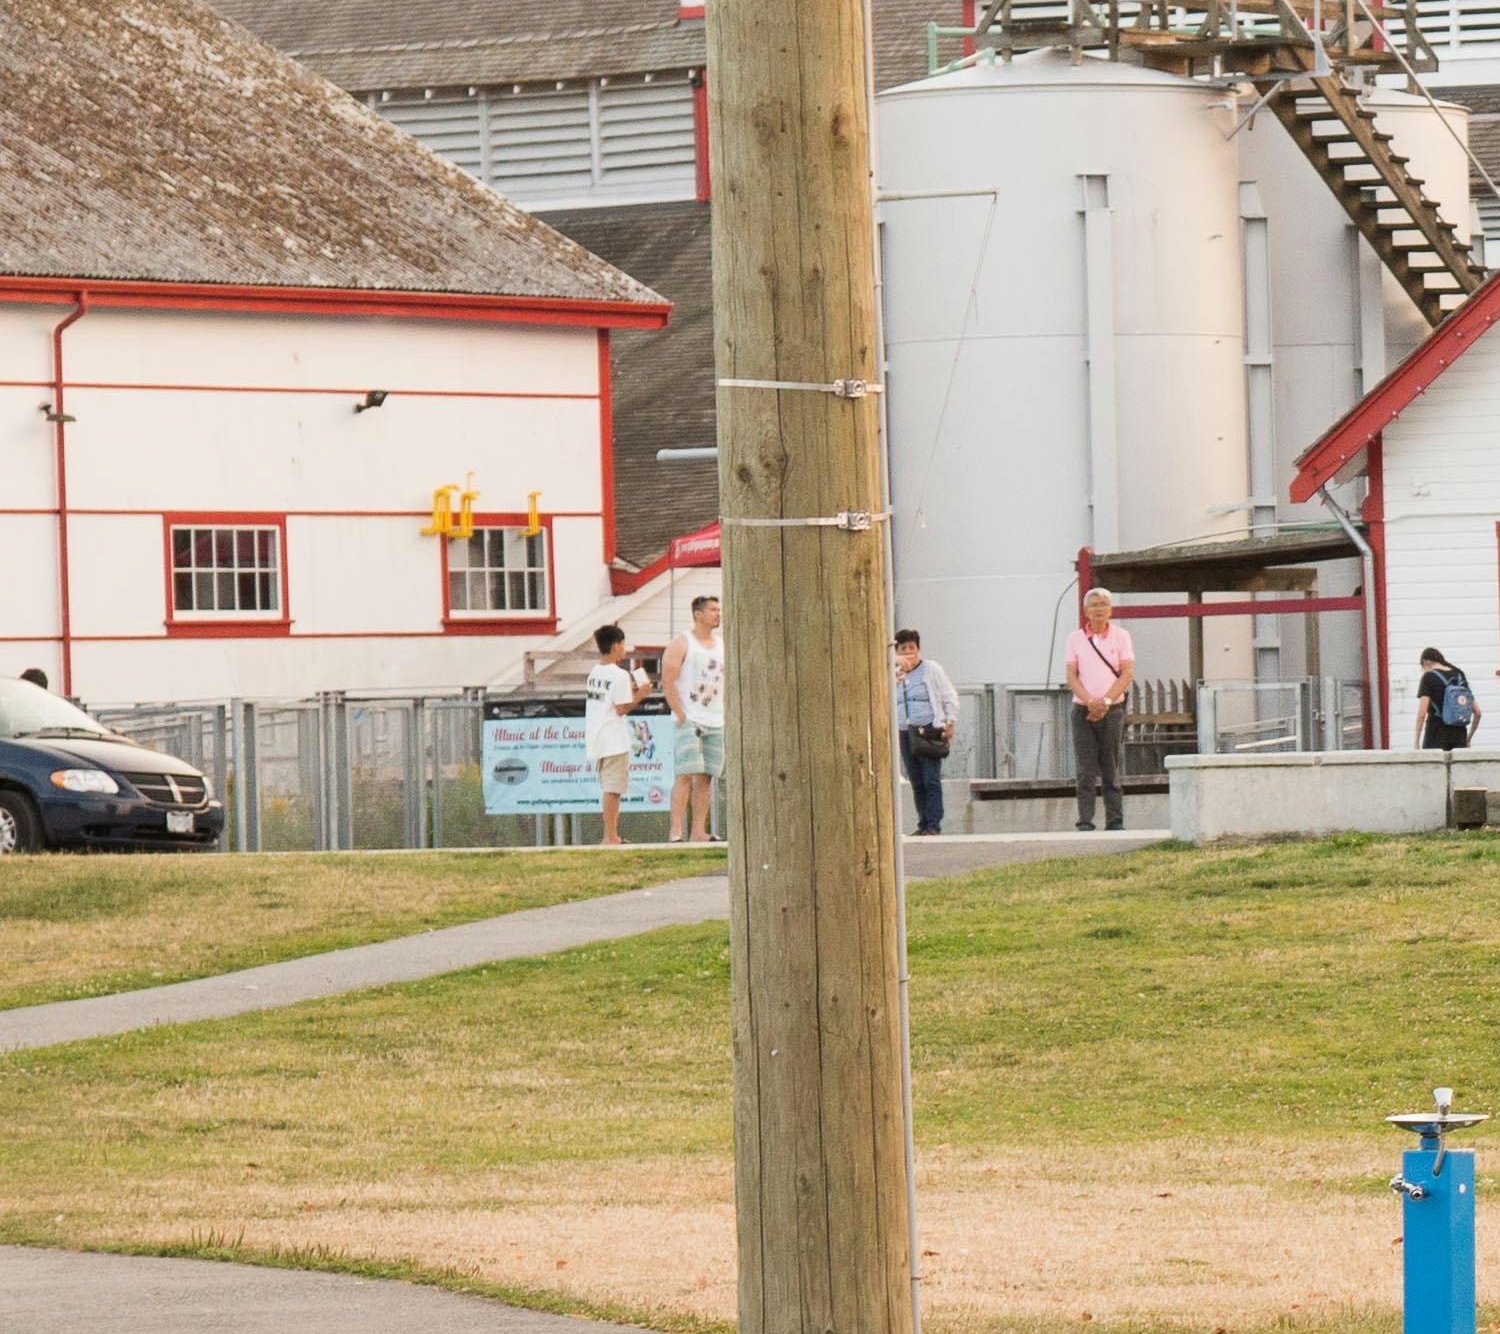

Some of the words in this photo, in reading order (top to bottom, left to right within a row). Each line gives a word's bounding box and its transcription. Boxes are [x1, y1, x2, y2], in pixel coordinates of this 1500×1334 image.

[493, 728, 525, 742] Music
[529, 727, 540, 740] at
[543, 725, 559, 740] the
[562, 725, 586, 740] Cann
[540, 760, 582, 777] Musique
